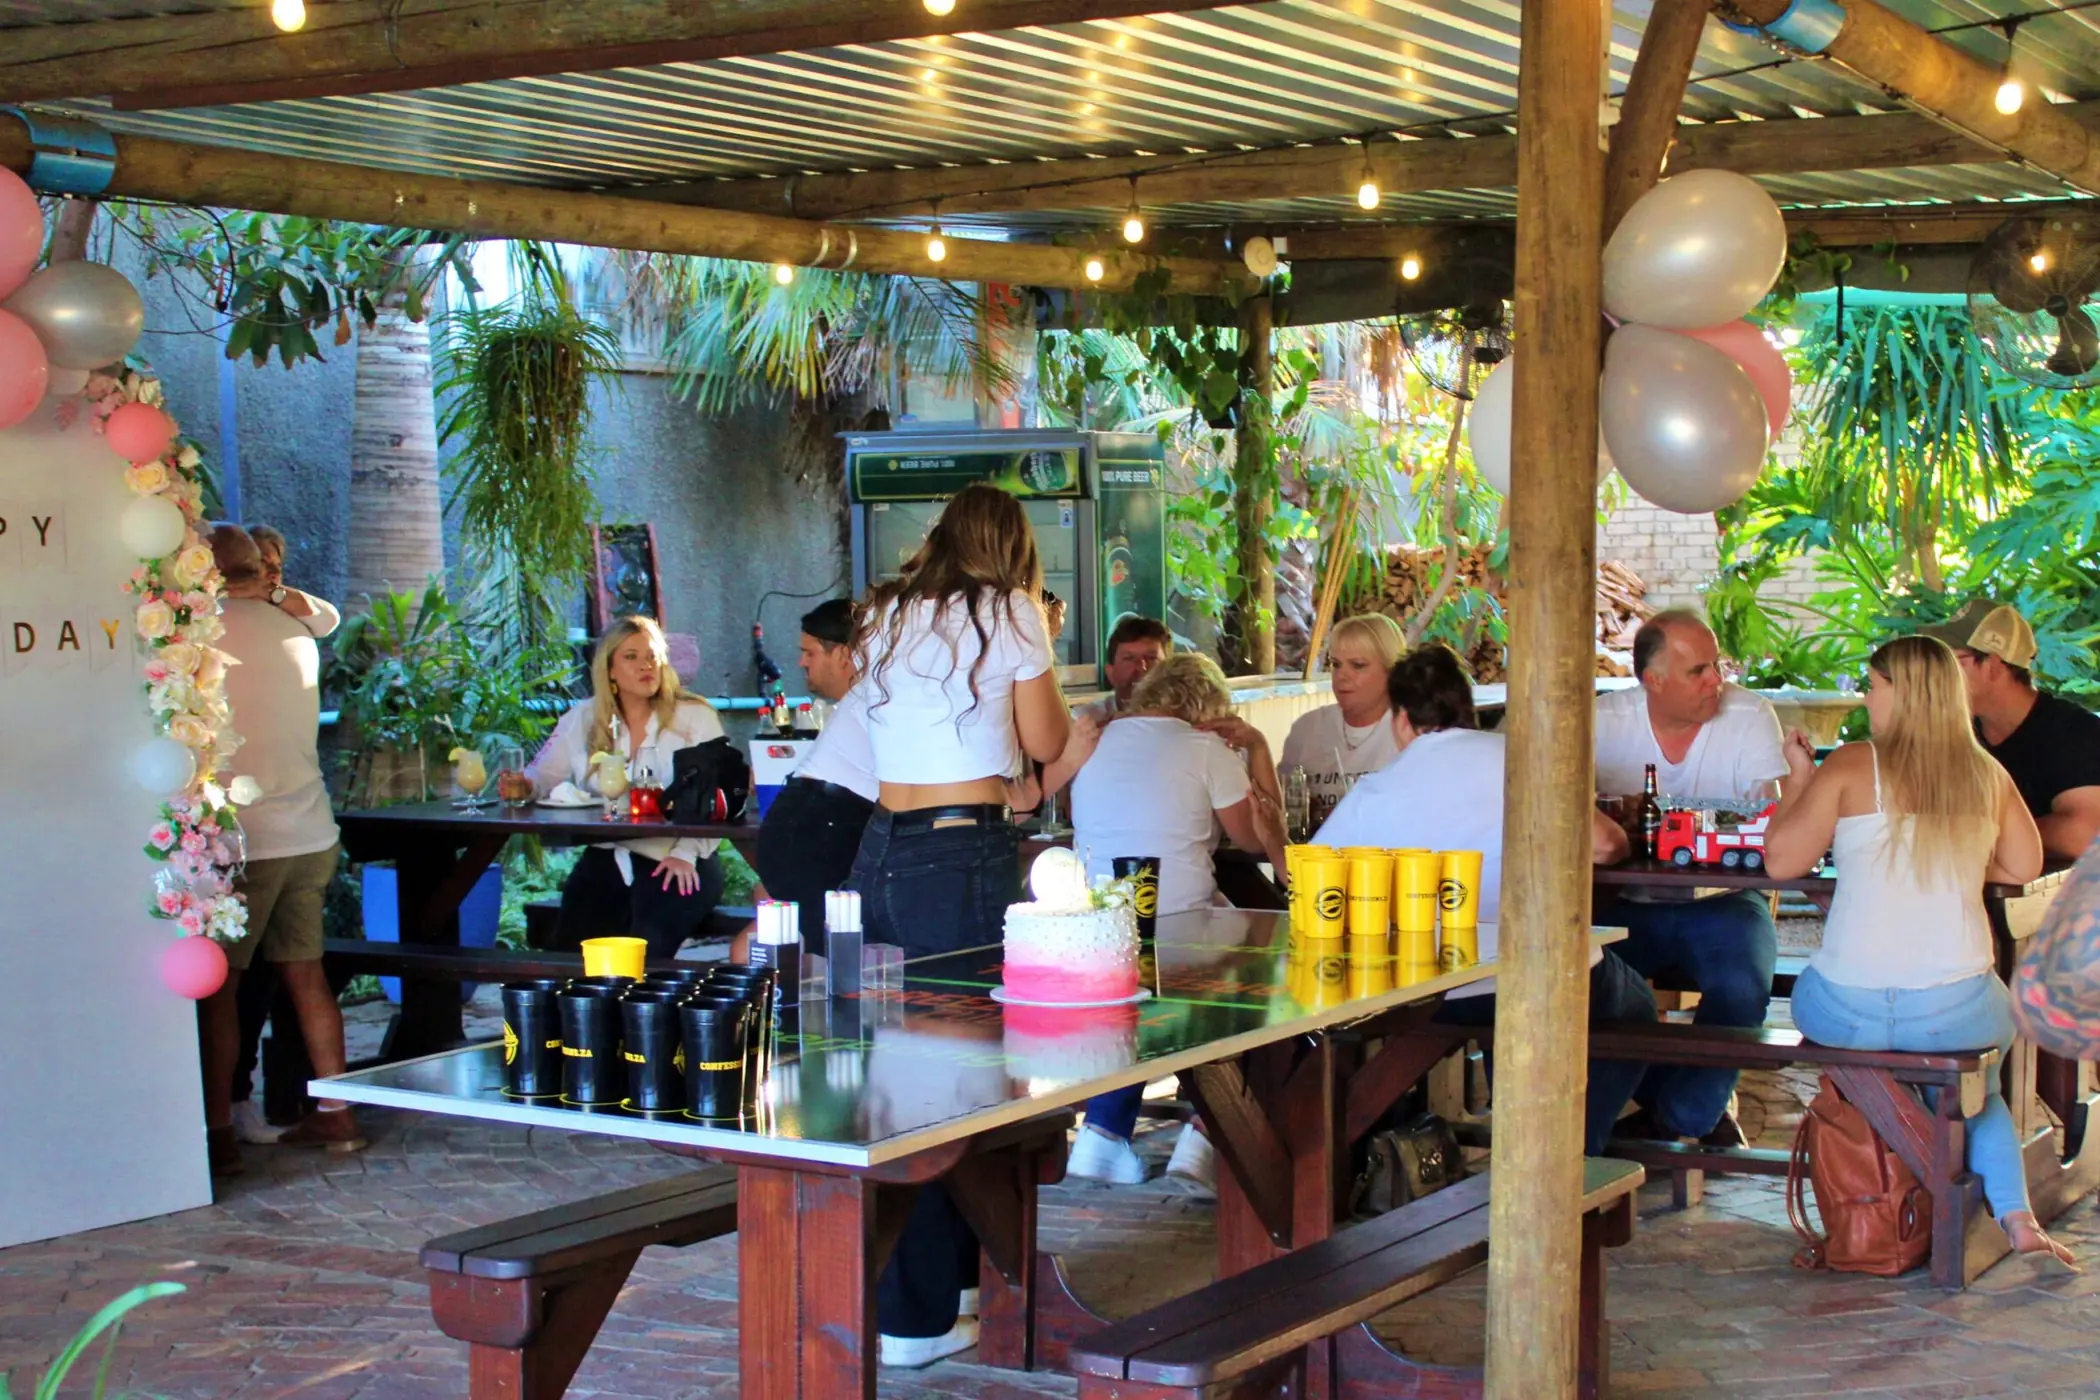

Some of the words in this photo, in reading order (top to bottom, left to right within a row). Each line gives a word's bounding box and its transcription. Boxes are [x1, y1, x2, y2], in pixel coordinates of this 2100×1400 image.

[1115, 470, 1133, 482] PURE
[1133, 470, 1150, 482] BEER
[14, 619, 120, 653] DAY
